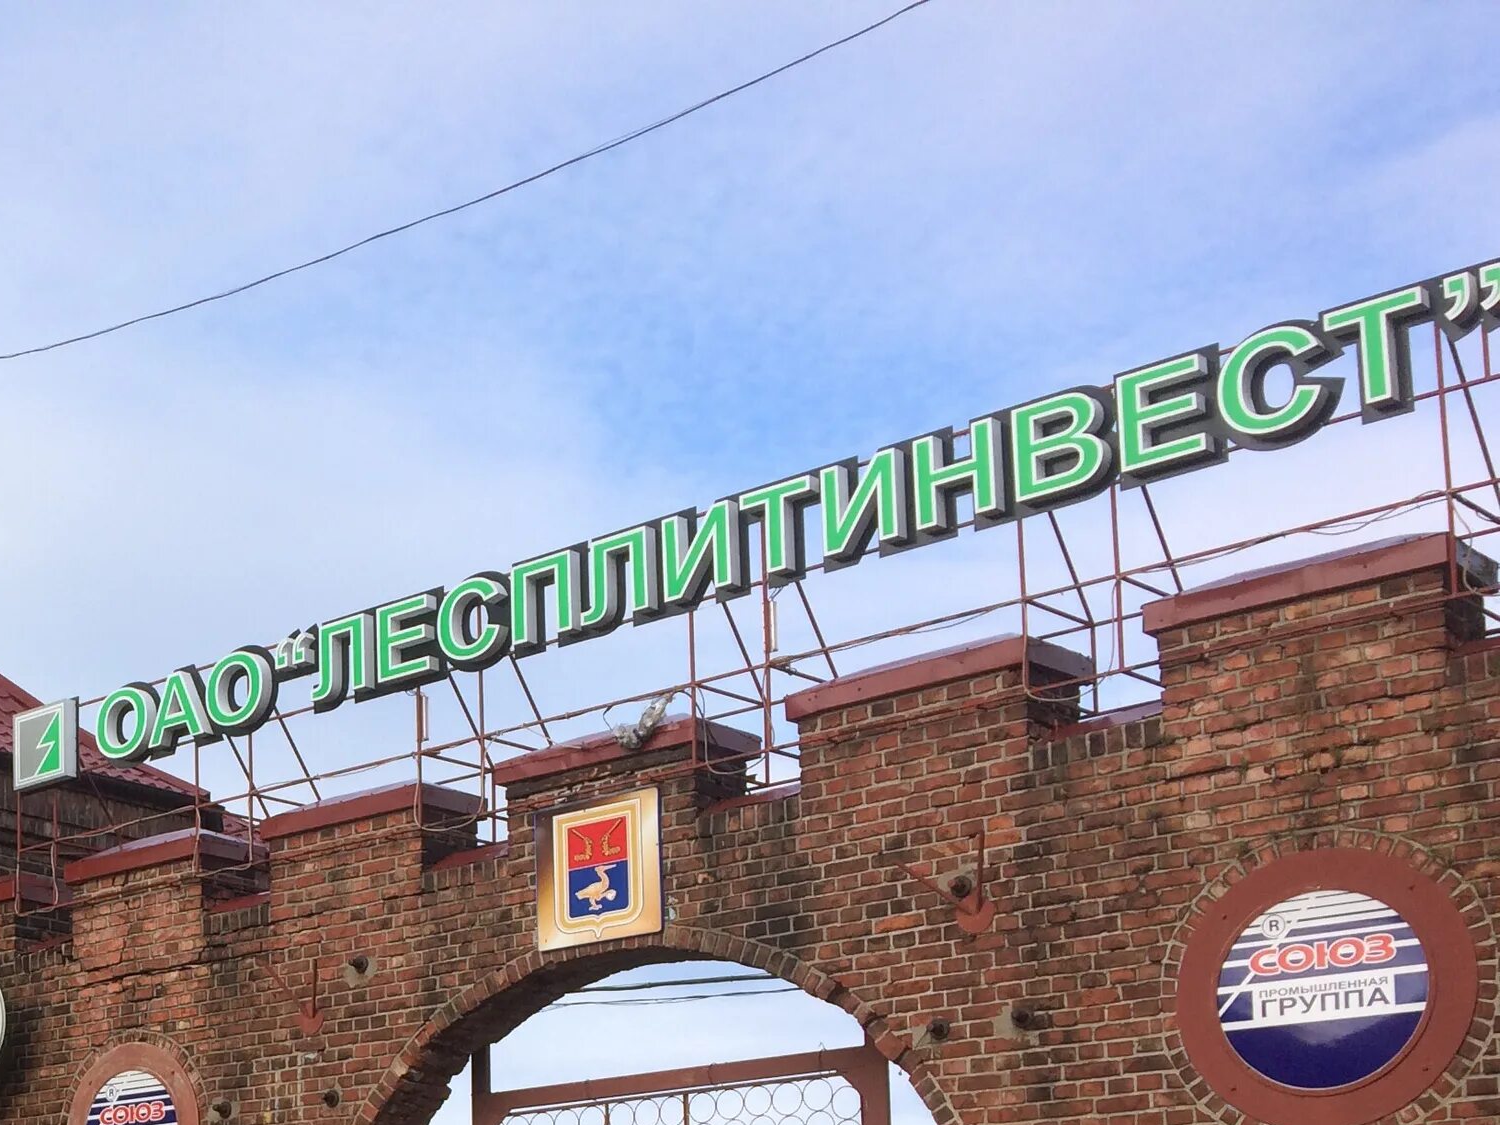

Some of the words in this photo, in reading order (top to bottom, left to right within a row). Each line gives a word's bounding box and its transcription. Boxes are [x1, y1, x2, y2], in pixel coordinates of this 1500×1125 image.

[95, 645, 276, 767] ОАО
[1248, 933, 1396, 976] СОЮЗ
[1258, 975, 1389, 999] ПРОМЫШЛЕННАЯ
[1260, 986, 1391, 1018] ГРУППА
